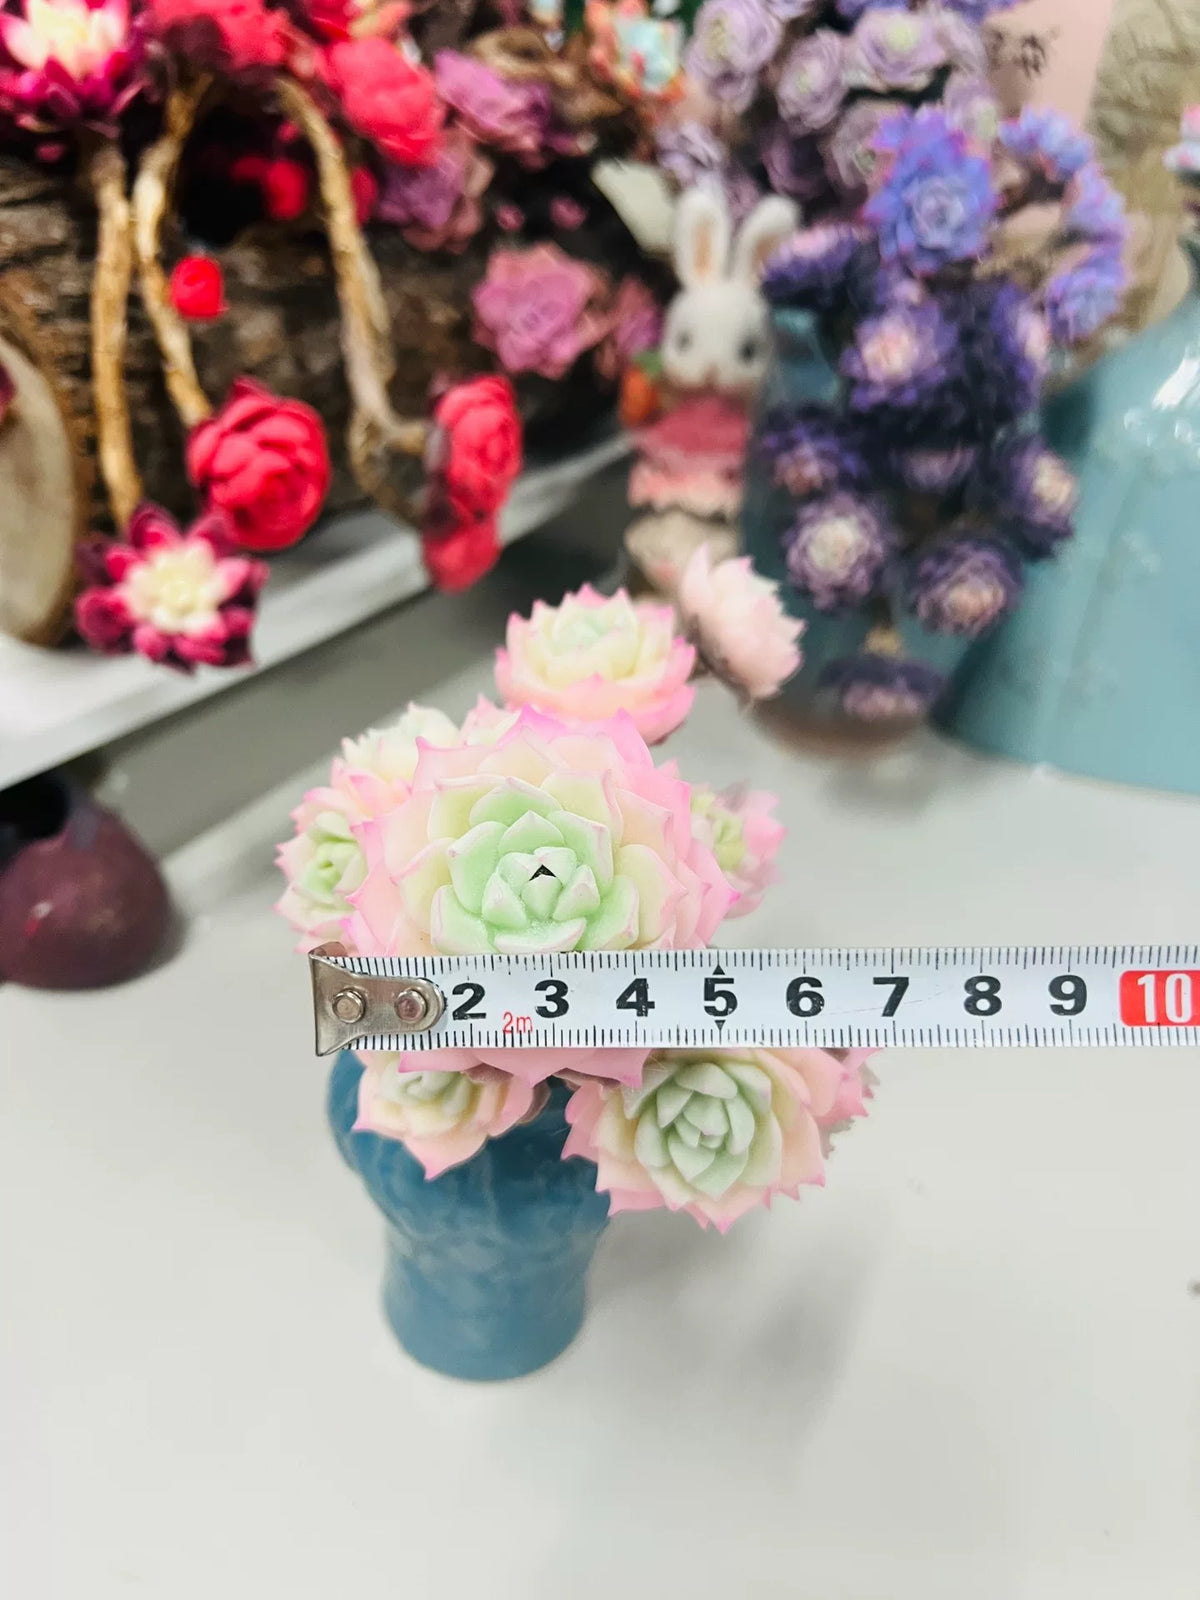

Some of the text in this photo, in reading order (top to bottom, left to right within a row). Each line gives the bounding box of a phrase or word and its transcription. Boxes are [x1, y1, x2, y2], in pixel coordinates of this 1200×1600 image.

[452, 972, 1192, 1024] 2 3 4 5 6 7 8 9 10
[502, 1012, 534, 1034] 2m
